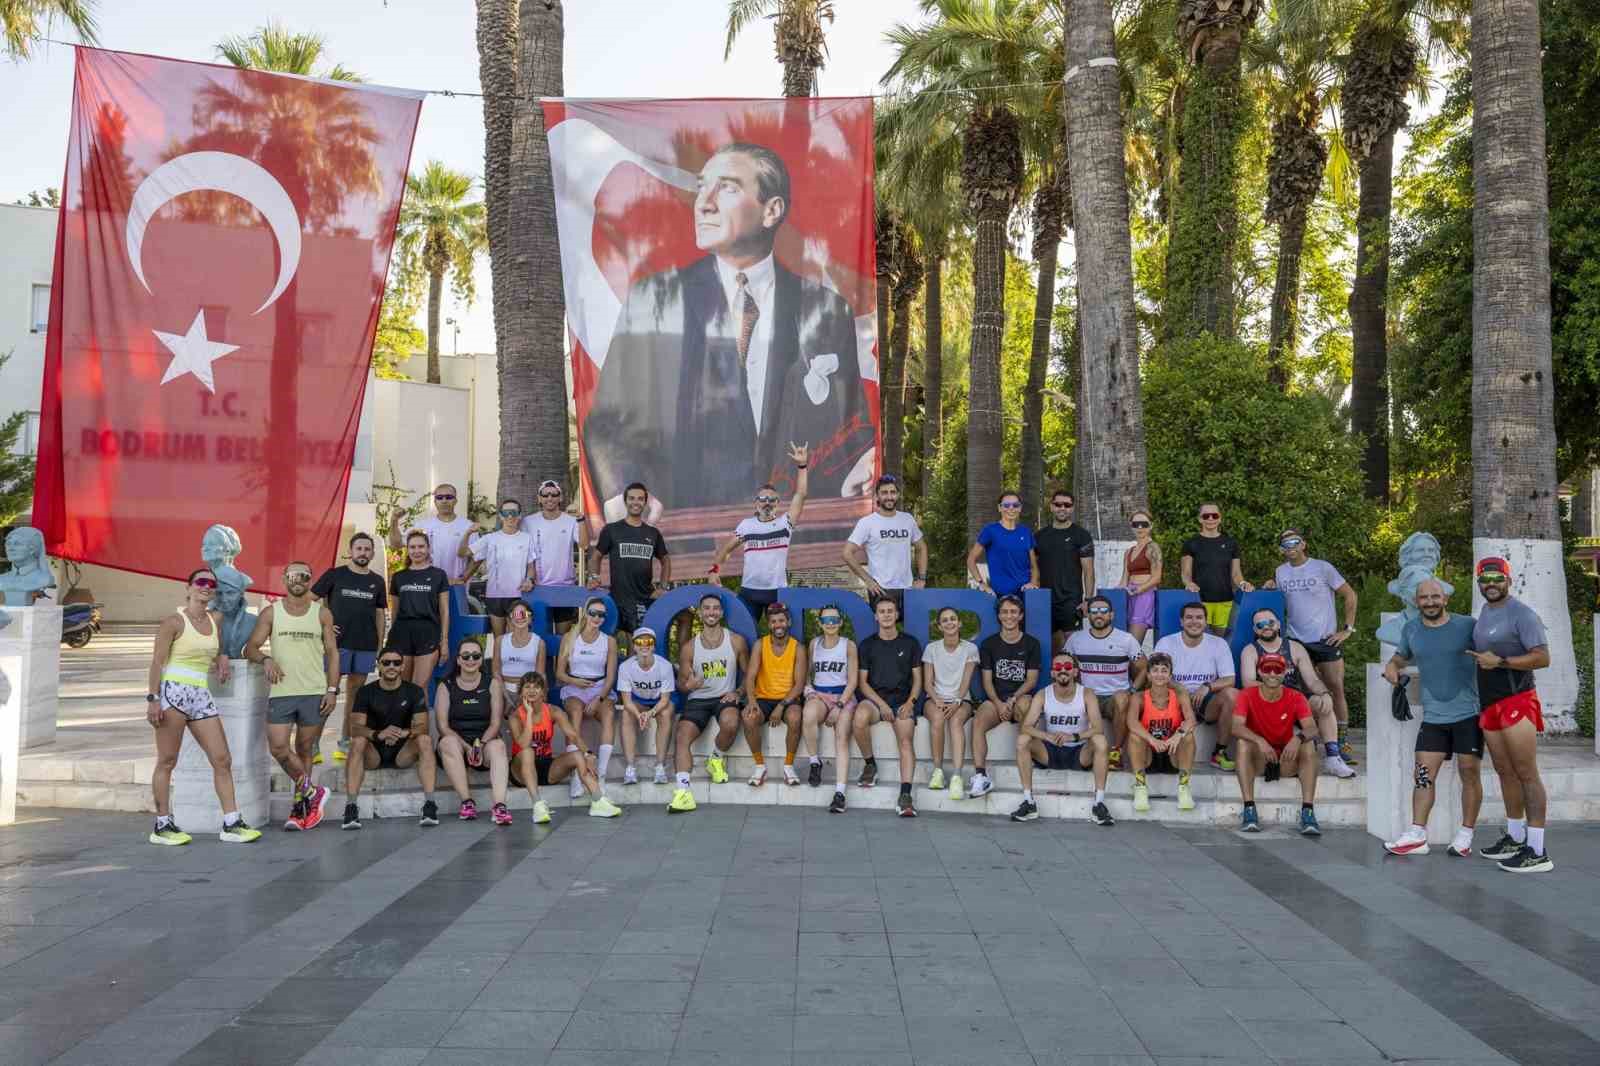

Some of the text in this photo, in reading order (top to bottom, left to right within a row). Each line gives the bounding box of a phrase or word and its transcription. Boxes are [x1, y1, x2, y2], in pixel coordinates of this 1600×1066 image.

[197, 391, 248, 417] T.C.
[81, 429, 206, 462] BODRUM
[880, 529, 909, 539] BOLD
[1050, 715, 1080, 726] BEAT
